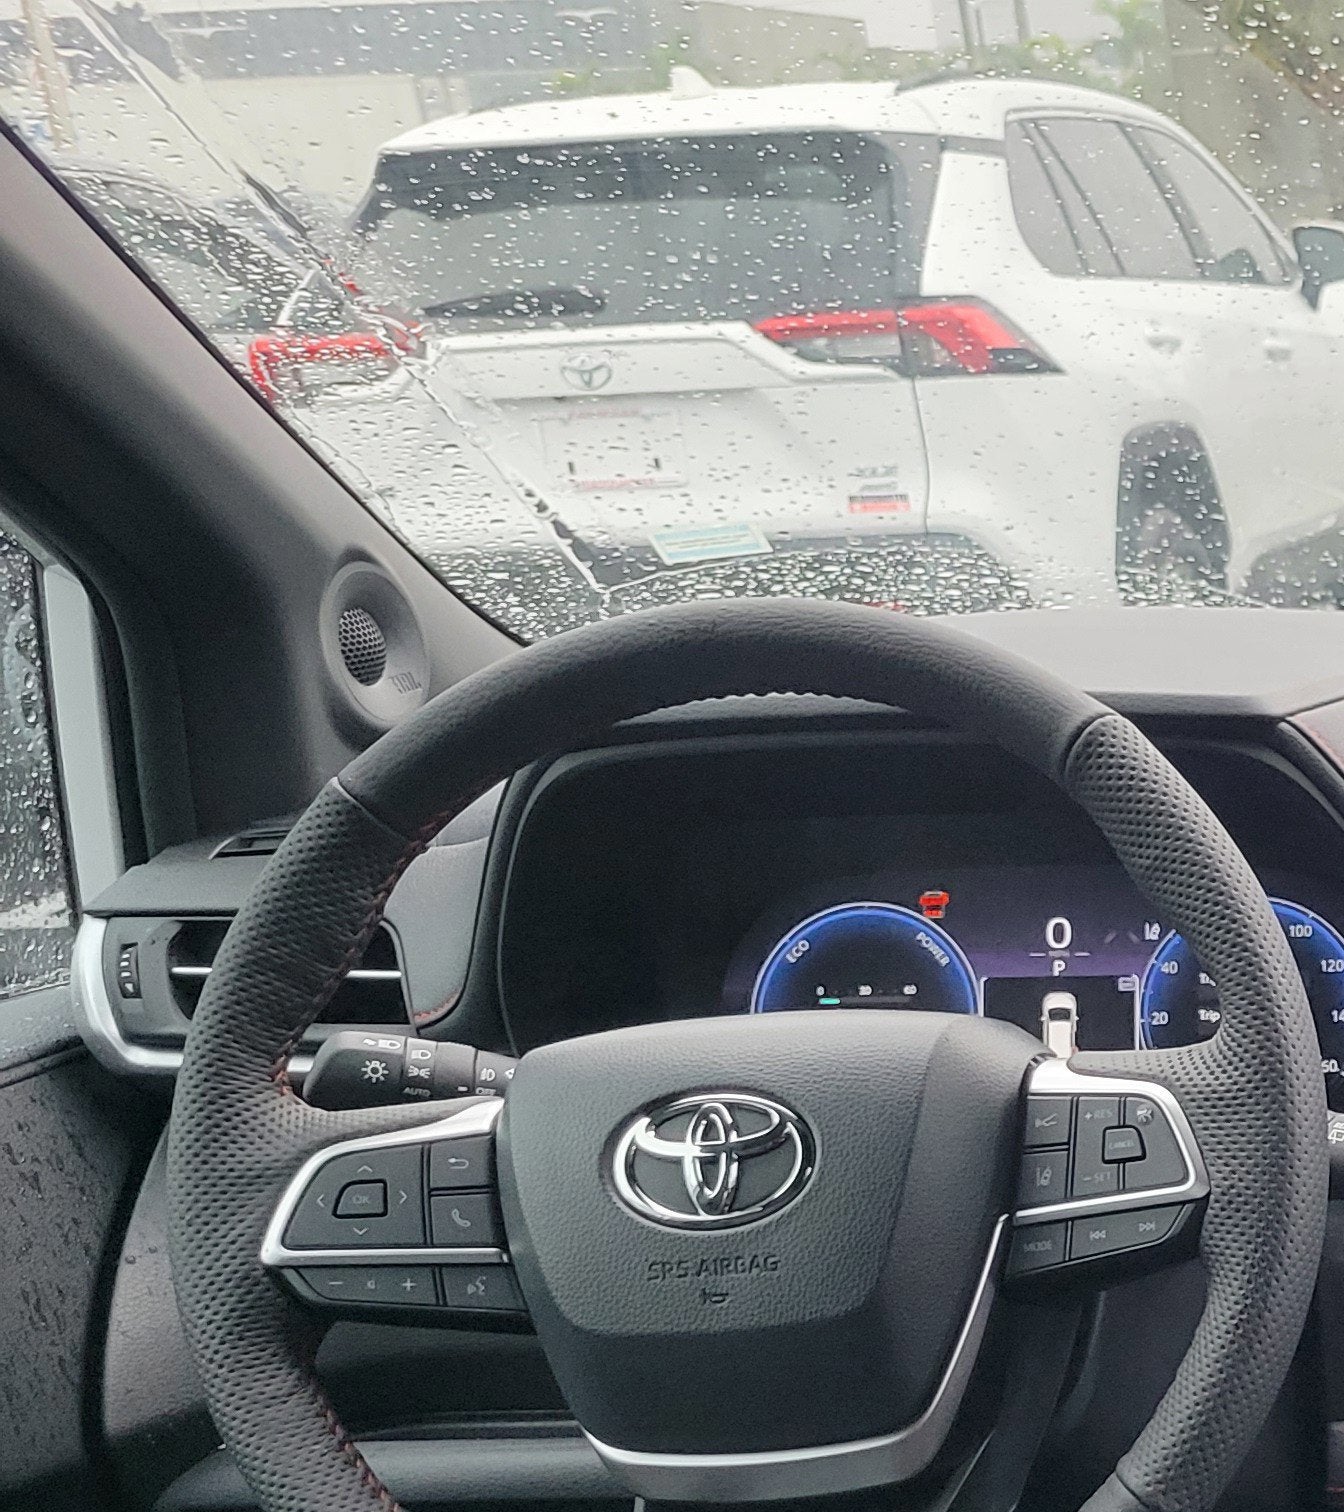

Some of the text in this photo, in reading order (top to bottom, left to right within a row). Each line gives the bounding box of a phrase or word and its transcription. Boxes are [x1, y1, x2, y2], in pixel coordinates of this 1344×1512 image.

[1045, 916, 1072, 950] 0
[1289, 924, 1313, 938] 100
[785, 939, 810, 964] ECO
[915, 931, 951, 967] POWER
[1052, 959, 1066, 977] P
[1160, 961, 1179, 975] 40
[1320, 959, 1344, 973] 120
[1151, 1011, 1169, 1025] 20
[695, 1254, 782, 1277] AIRBAG
